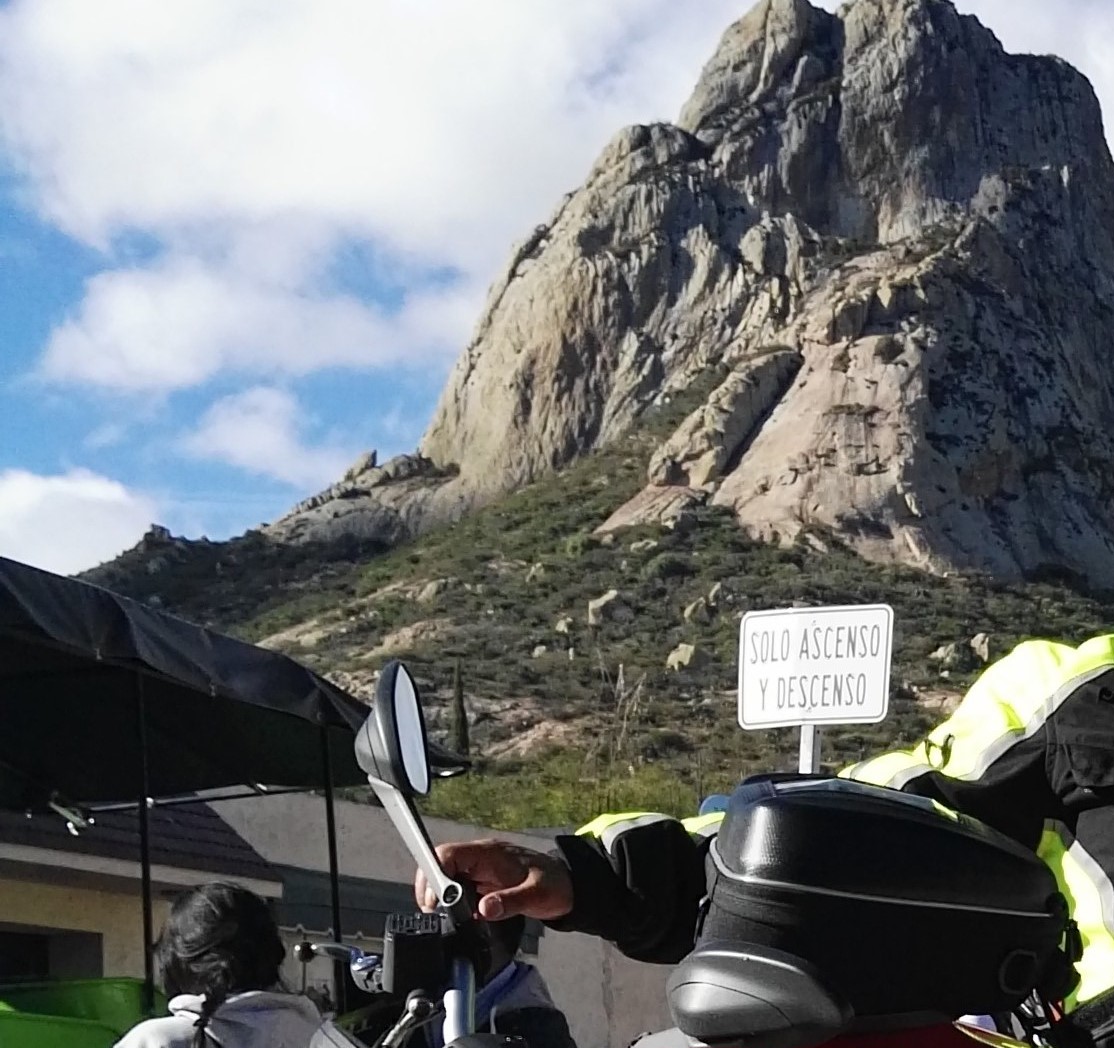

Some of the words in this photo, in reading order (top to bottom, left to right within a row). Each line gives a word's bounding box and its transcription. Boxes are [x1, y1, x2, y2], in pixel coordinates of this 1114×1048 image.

[750, 628, 790, 664] SOLO
[799, 624, 881, 660] ASCENSO
[759, 677, 768, 710] Y
[777, 673, 867, 709] DESCENSO
